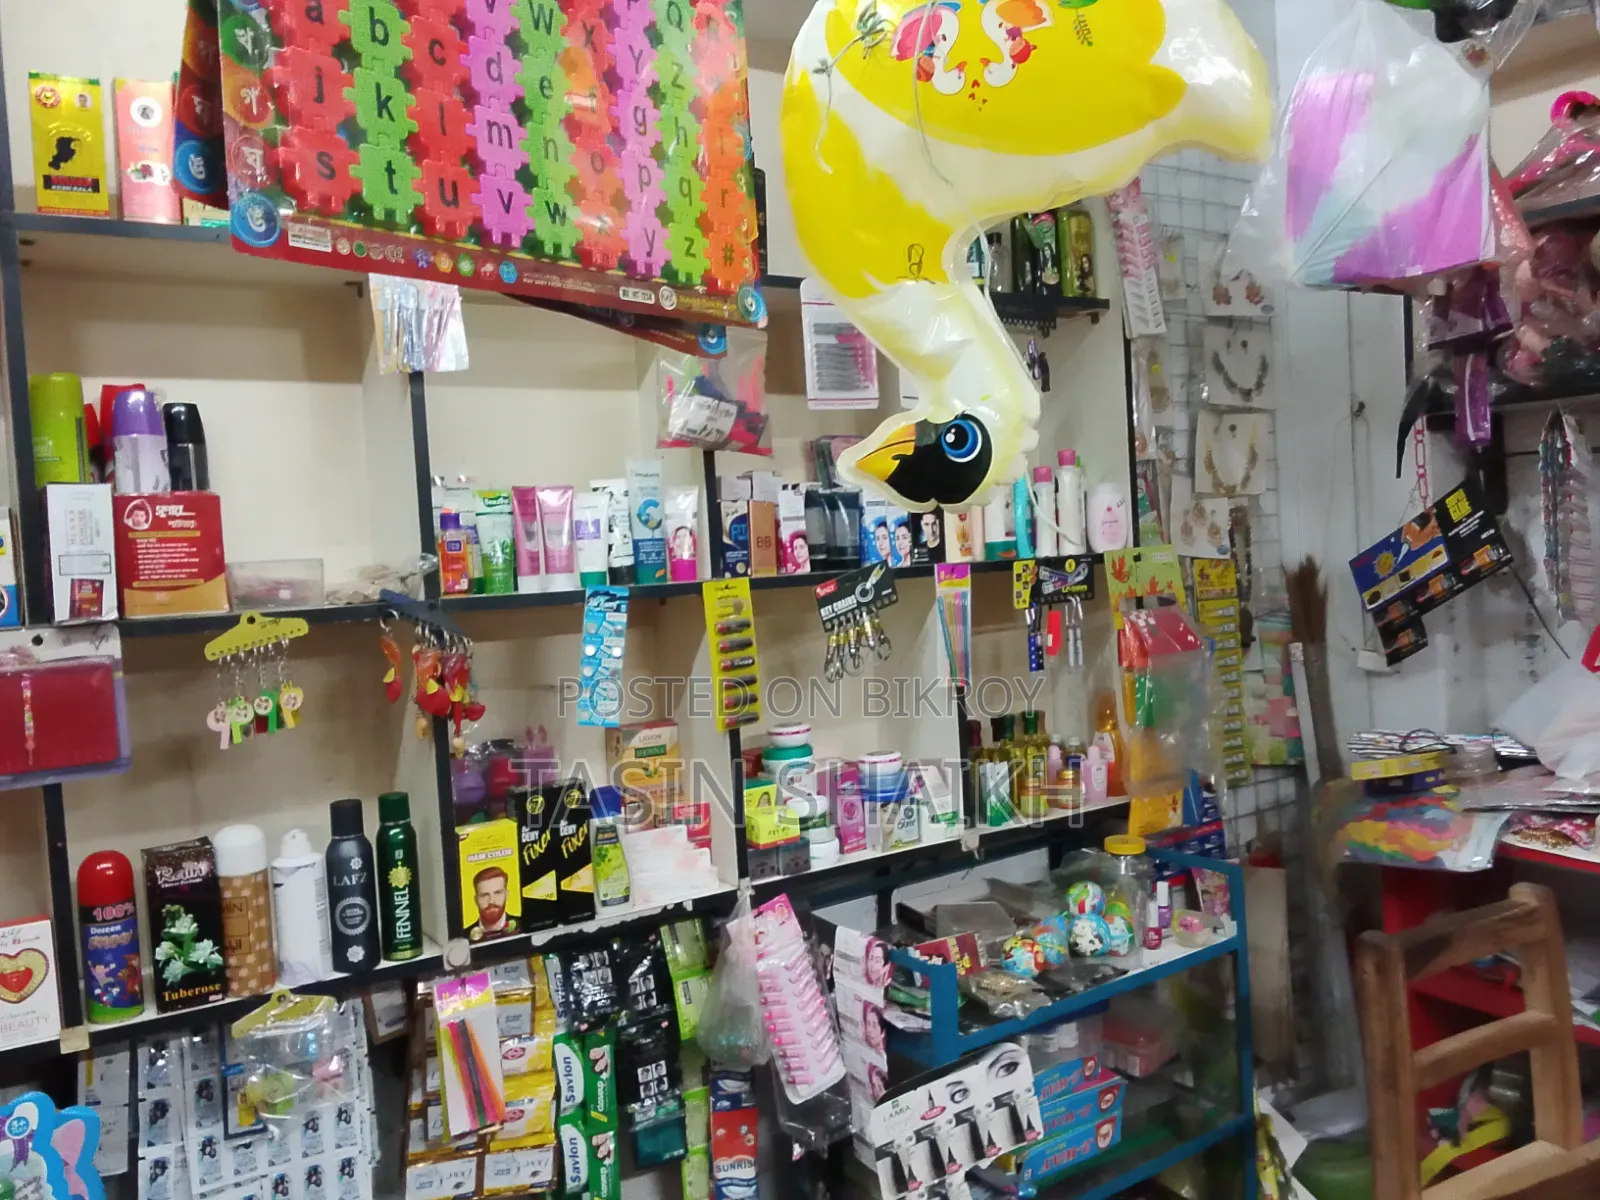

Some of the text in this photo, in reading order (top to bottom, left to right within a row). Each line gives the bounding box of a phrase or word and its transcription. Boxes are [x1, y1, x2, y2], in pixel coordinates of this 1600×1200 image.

[305, 0, 324, 25] a
[369, 6, 390, 46] b
[429, 39, 446, 66] c
[486, 52, 503, 85] d
[539, 75, 554, 100] e
[634, 105, 648, 135] g
[674, 116, 688, 148] h
[629, 45, 643, 74] Y
[672, 61, 685, 89] Z
[314, 65, 325, 104] j
[375, 82, 395, 122] k
[486, 119, 513, 149] m
[543, 136, 559, 162] n
[590, 152, 605, 175] o
[638, 163, 651, 193] p
[679, 176, 692, 206] q
[720, 188, 729, 208] r
[316, 151, 336, 181] s
[385, 160, 398, 195] t
[438, 177, 459, 208] u
[497, 189, 513, 215] v
[545, 200, 566, 227] w
[644, 228, 656, 257] y
[684, 236, 697, 258] z
[467, 847, 513, 863] HAIR COLOR
[333, 872, 368, 886] LAFZ
[93, 903, 135, 921] 100%
[394, 886, 412, 939] FENNEL
[162, 983, 222, 1001] Tuberose
[0, 1014, 50, 1034] BEAUTY
[563, 1056, 576, 1104] Savlon
[883, 1104, 911, 1122] LAMIA
[570, 1137, 582, 1183] Savlon
